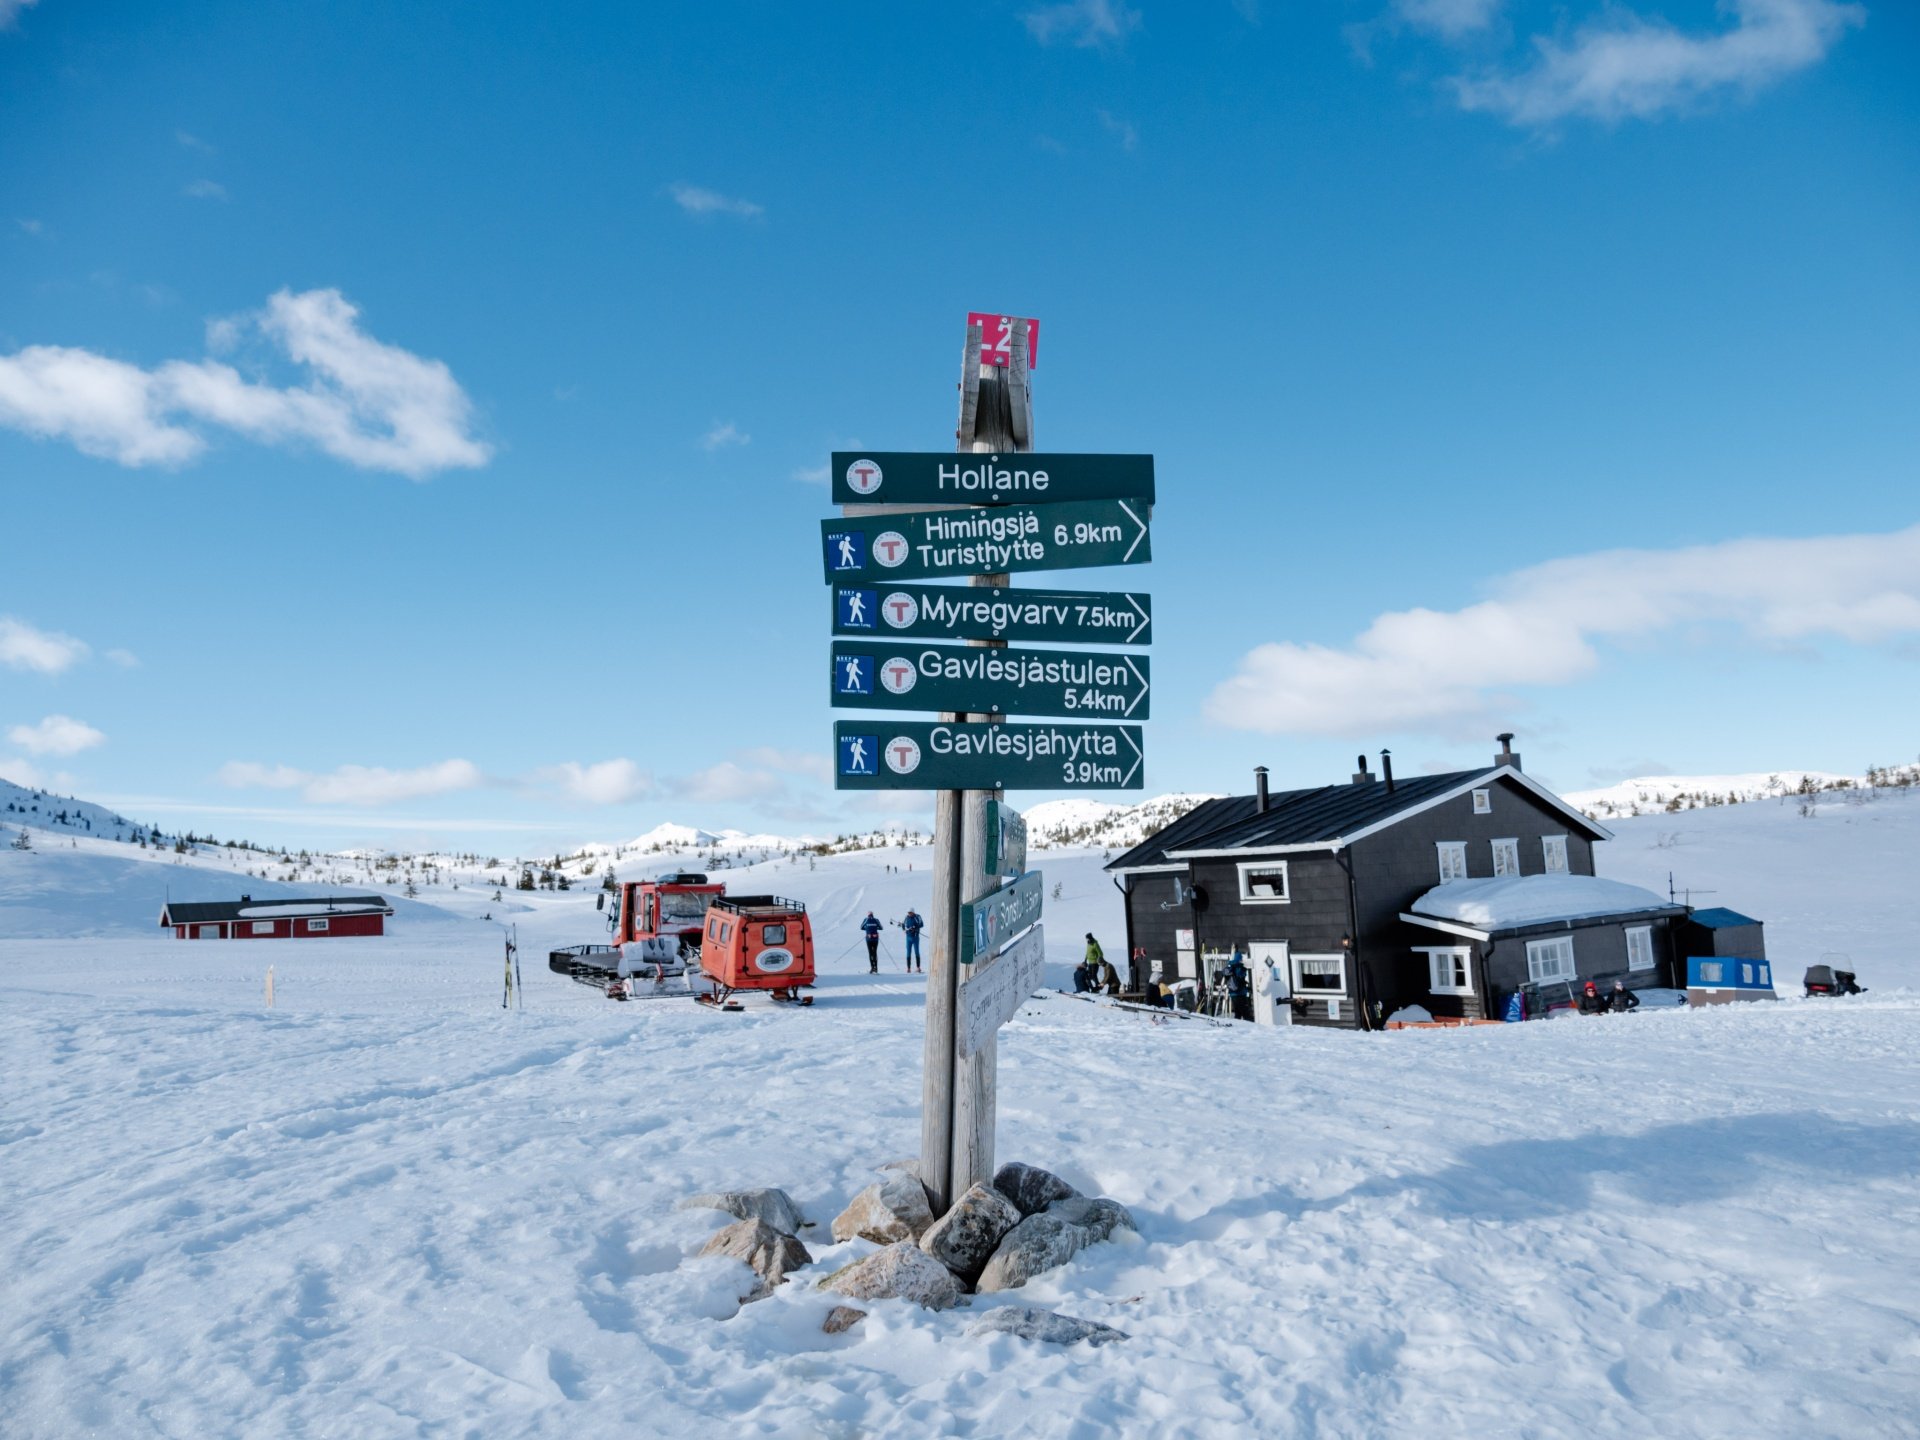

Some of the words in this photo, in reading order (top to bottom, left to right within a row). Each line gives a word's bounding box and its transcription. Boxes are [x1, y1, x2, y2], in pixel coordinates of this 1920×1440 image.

[938, 463, 1050, 491] Hollane
[1054, 522, 1122, 546] 6.9km
[916, 539, 1045, 567] Turisthytte
[921, 593, 1069, 630] Myregvarv
[1075, 606, 1136, 628] 7.5km
[1064, 688, 1126, 711] 5.4km
[1062, 762, 1122, 783] 3.9km
